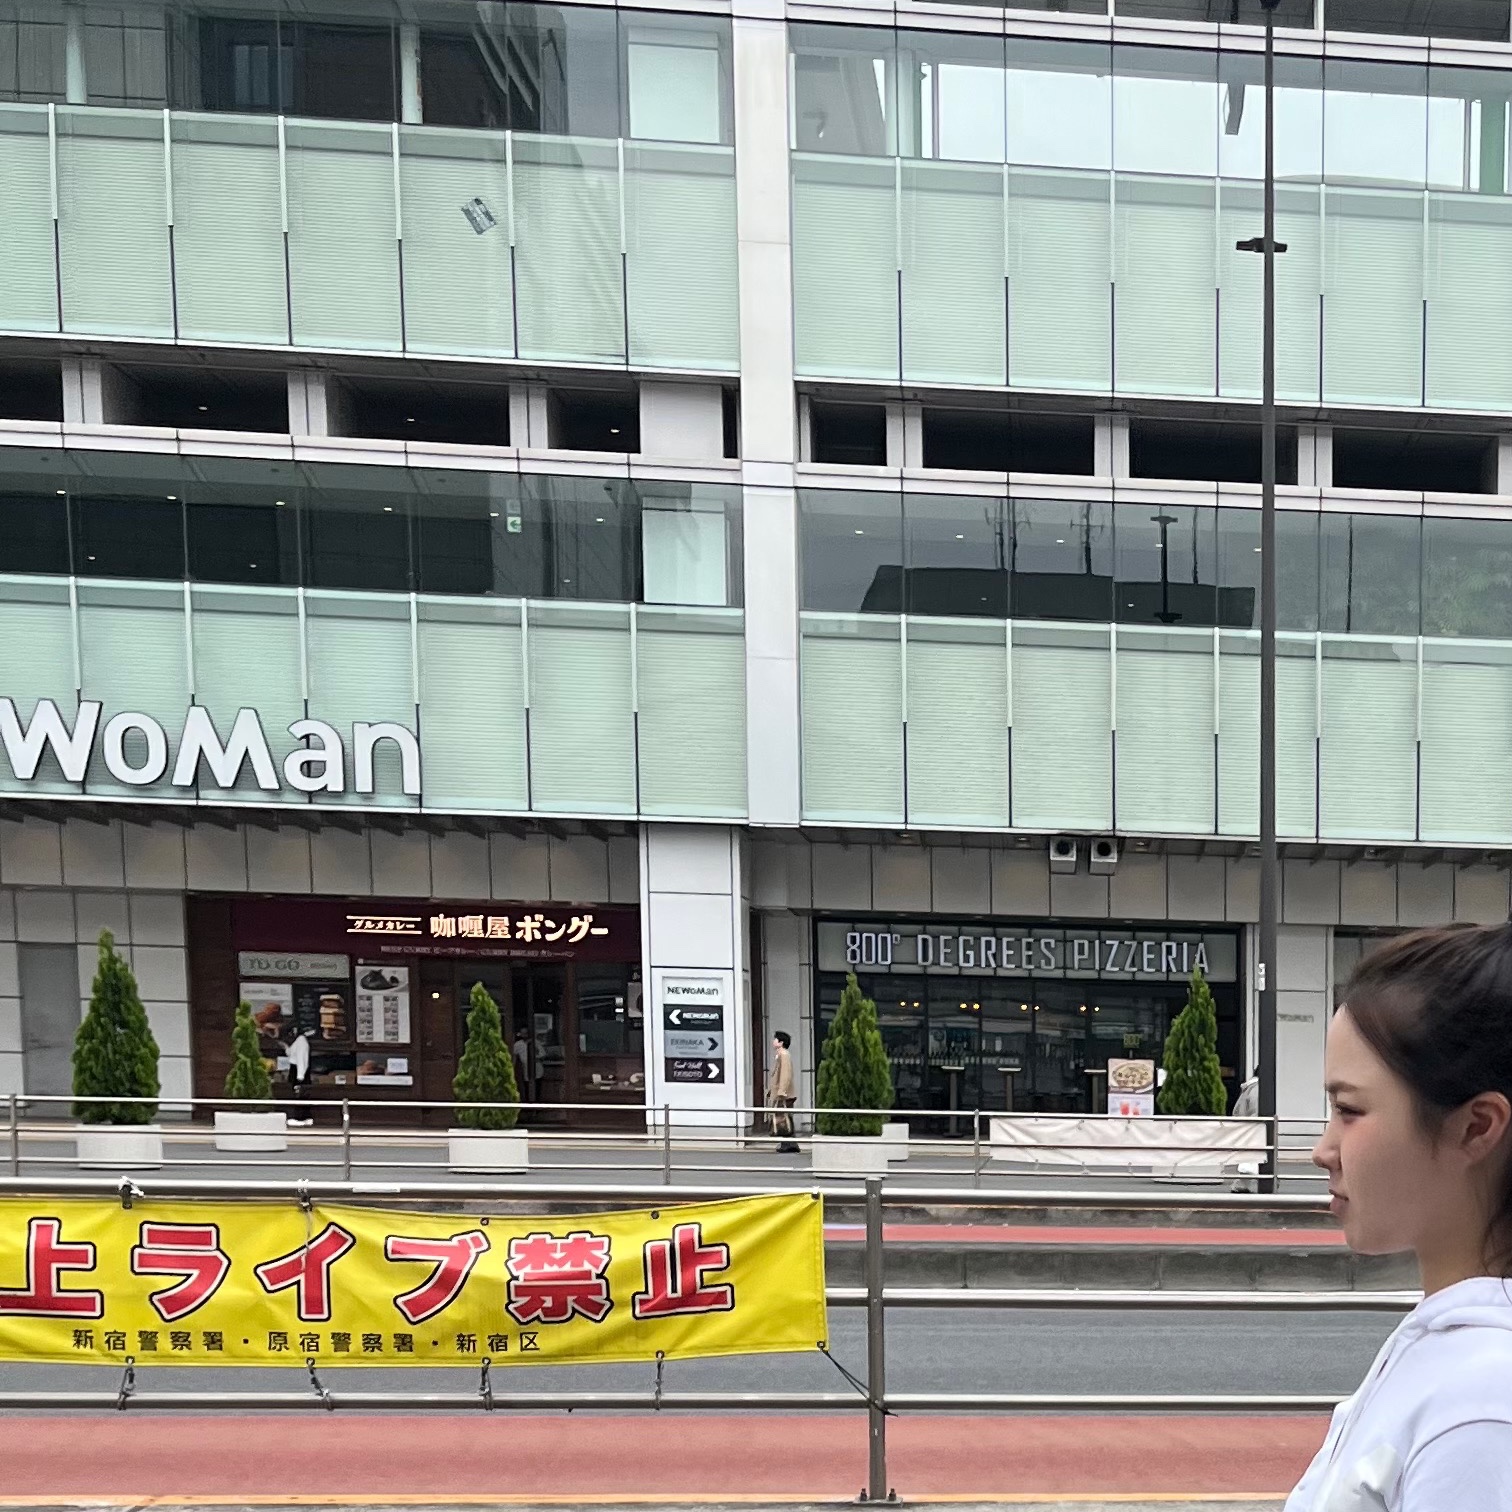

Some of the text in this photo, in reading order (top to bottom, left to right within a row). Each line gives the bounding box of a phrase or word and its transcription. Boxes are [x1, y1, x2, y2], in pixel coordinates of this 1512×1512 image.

[354, 920, 415, 930] グルメカレー
[917, 934, 1056, 970] DEGREES
[1073, 938, 1210, 974] PIZZERIA
[0, 1215, 734, 1324] 上ライブ禁止
[71, 1327, 542, 1354] 新宿警察署・原宿警察署・新宿区
